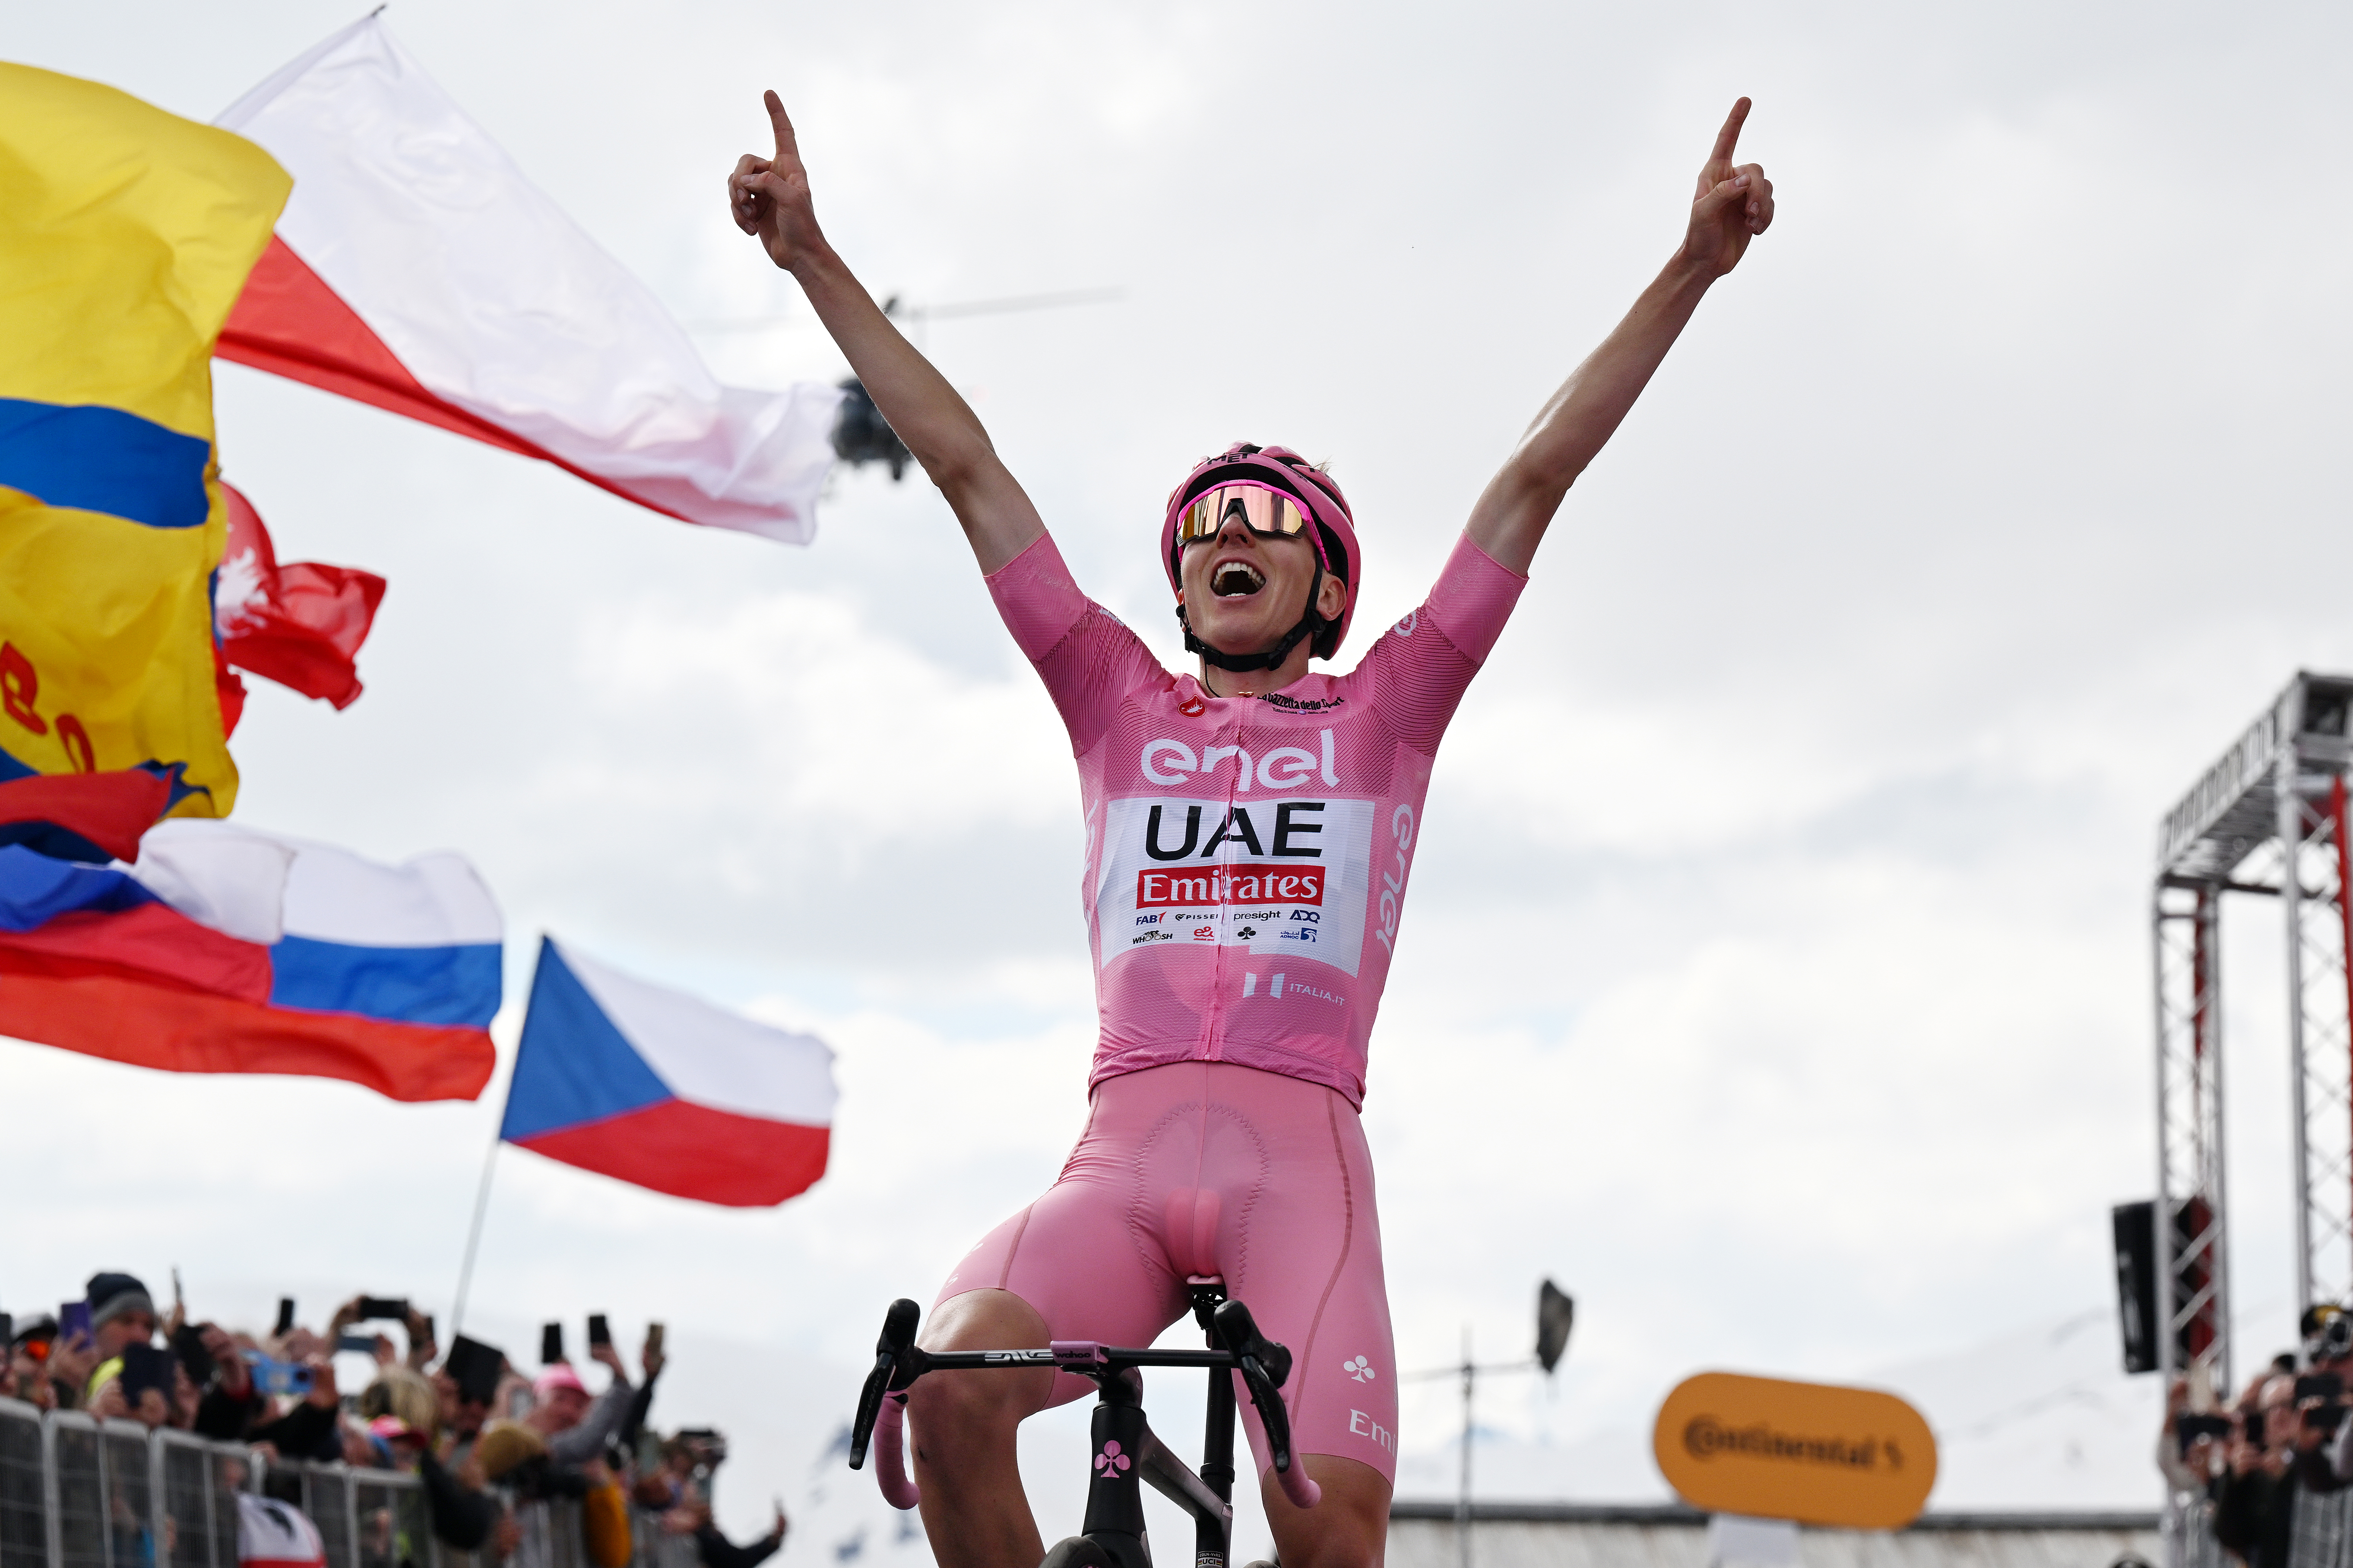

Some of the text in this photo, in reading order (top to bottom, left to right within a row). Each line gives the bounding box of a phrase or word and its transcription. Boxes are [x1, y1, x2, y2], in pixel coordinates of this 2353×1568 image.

[1208, 453, 1252, 465] MET
[1427, 618, 1456, 649] #GIRODITALIA
[1300, 700, 1321, 710] dello
[1141, 729, 1340, 791] enel
[1146, 802, 1326, 861] UAE
[1143, 869, 1317, 902] Emirates
[1233, 910, 1281, 921] presight
[1289, 909, 1320, 924] ADQ
[1194, 926, 1214, 937] e&
[1289, 983, 1345, 1006] ITALIA.IT
[1055, 1350, 1091, 1359] wahoo
[1684, 1413, 1877, 1470] Continental
